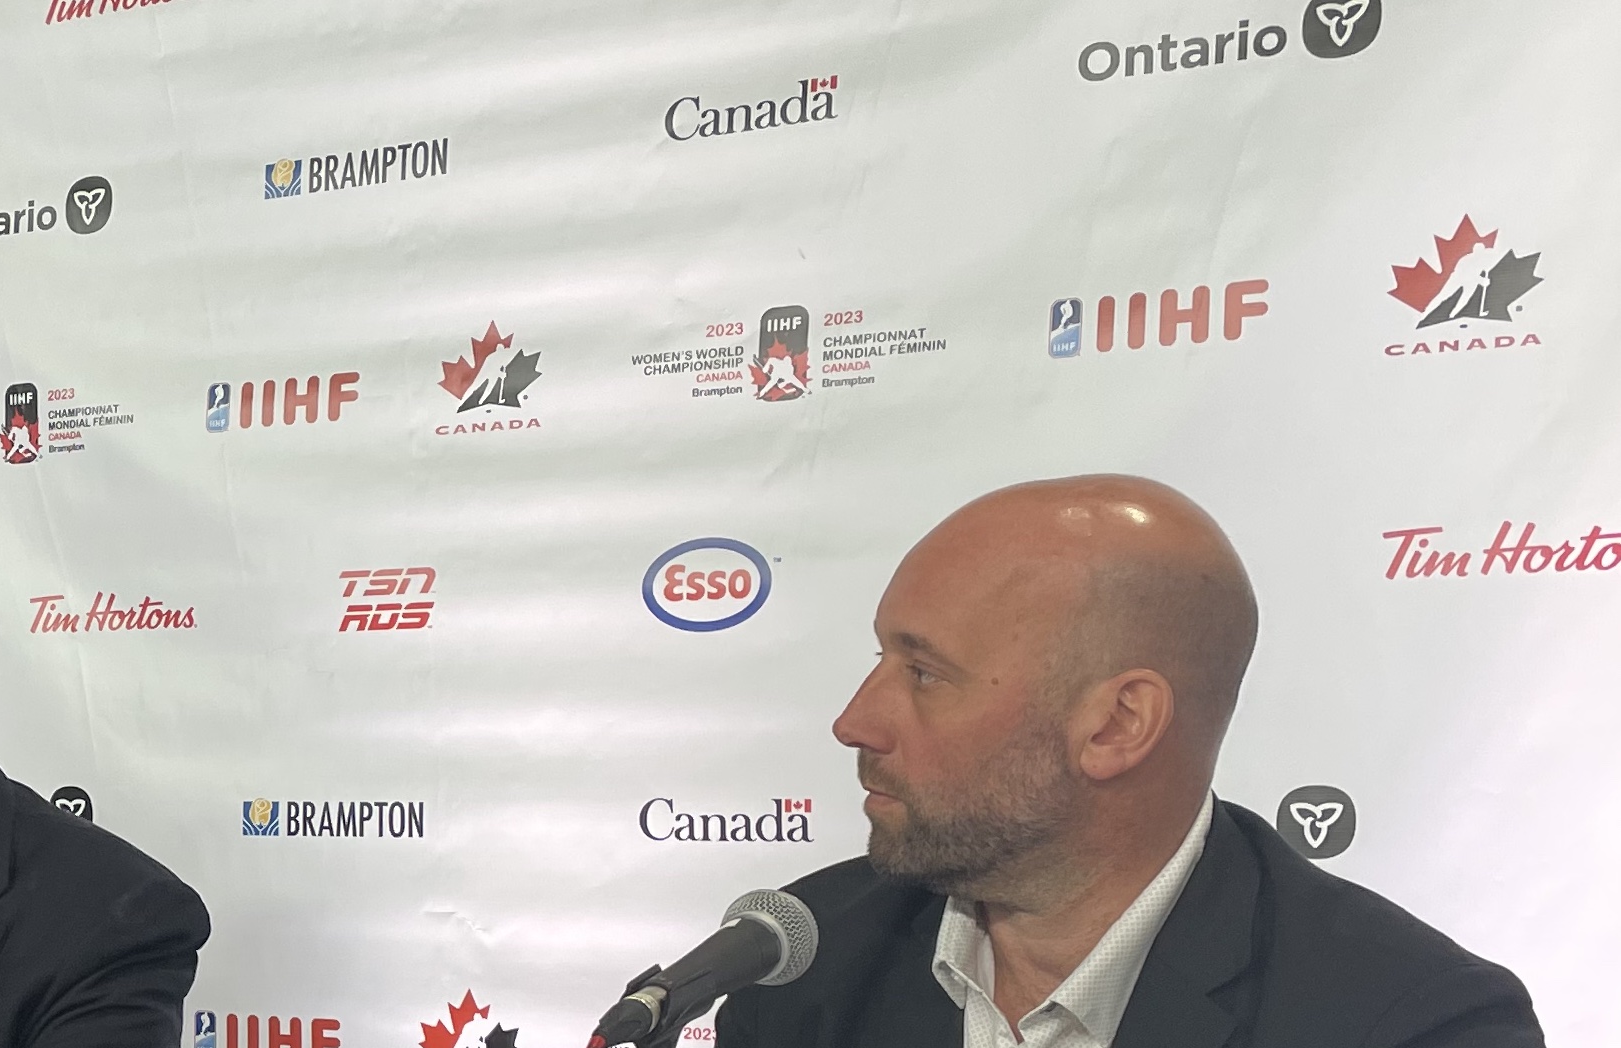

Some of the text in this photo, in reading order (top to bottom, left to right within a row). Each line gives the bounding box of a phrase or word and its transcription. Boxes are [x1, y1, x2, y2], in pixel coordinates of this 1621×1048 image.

[1077, 19, 1288, 82] Ontario
[665, 79, 838, 141] Canada
[309, 138, 449, 194] BRAMPTON
[766, 316, 802, 333] IIHF
[823, 309, 864, 327] 2023
[1096, 278, 1269, 353] IIHF
[706, 322, 744, 338] 2023
[823, 327, 926, 348] CHAMPIONNAT
[822, 338, 946, 362] MONDIAL FÉMININ
[1052, 341, 1076, 353] IIHF
[1384, 332, 1543, 357] CANADA
[631, 345, 744, 366] WOMEN'S WORLD
[643, 357, 744, 376] CHAMPIONSHIP
[696, 370, 743, 383] CANADA
[822, 360, 871, 374] CANADA
[822, 374, 875, 388] Brampton
[9, 392, 34, 405] IIHF
[48, 388, 75, 401] 2023
[239, 372, 361, 429] IIHF
[691, 385, 743, 399] Brampton
[48, 404, 120, 420] CHAMPIONNAT
[48, 413, 134, 431] MONDIAL FÉMININ
[48, 431, 82, 441] CANADA
[435, 418, 542, 436] CANADA
[1382, 520, 1621, 580] Tim Horto
[339, 567, 436, 598] TSN
[662, 564, 752, 602] Esso
[30, 592, 197, 634] Tim Hortons
[339, 602, 434, 632] RDS
[286, 801, 424, 838] BRAMPTON
[638, 797, 814, 843] Canada
